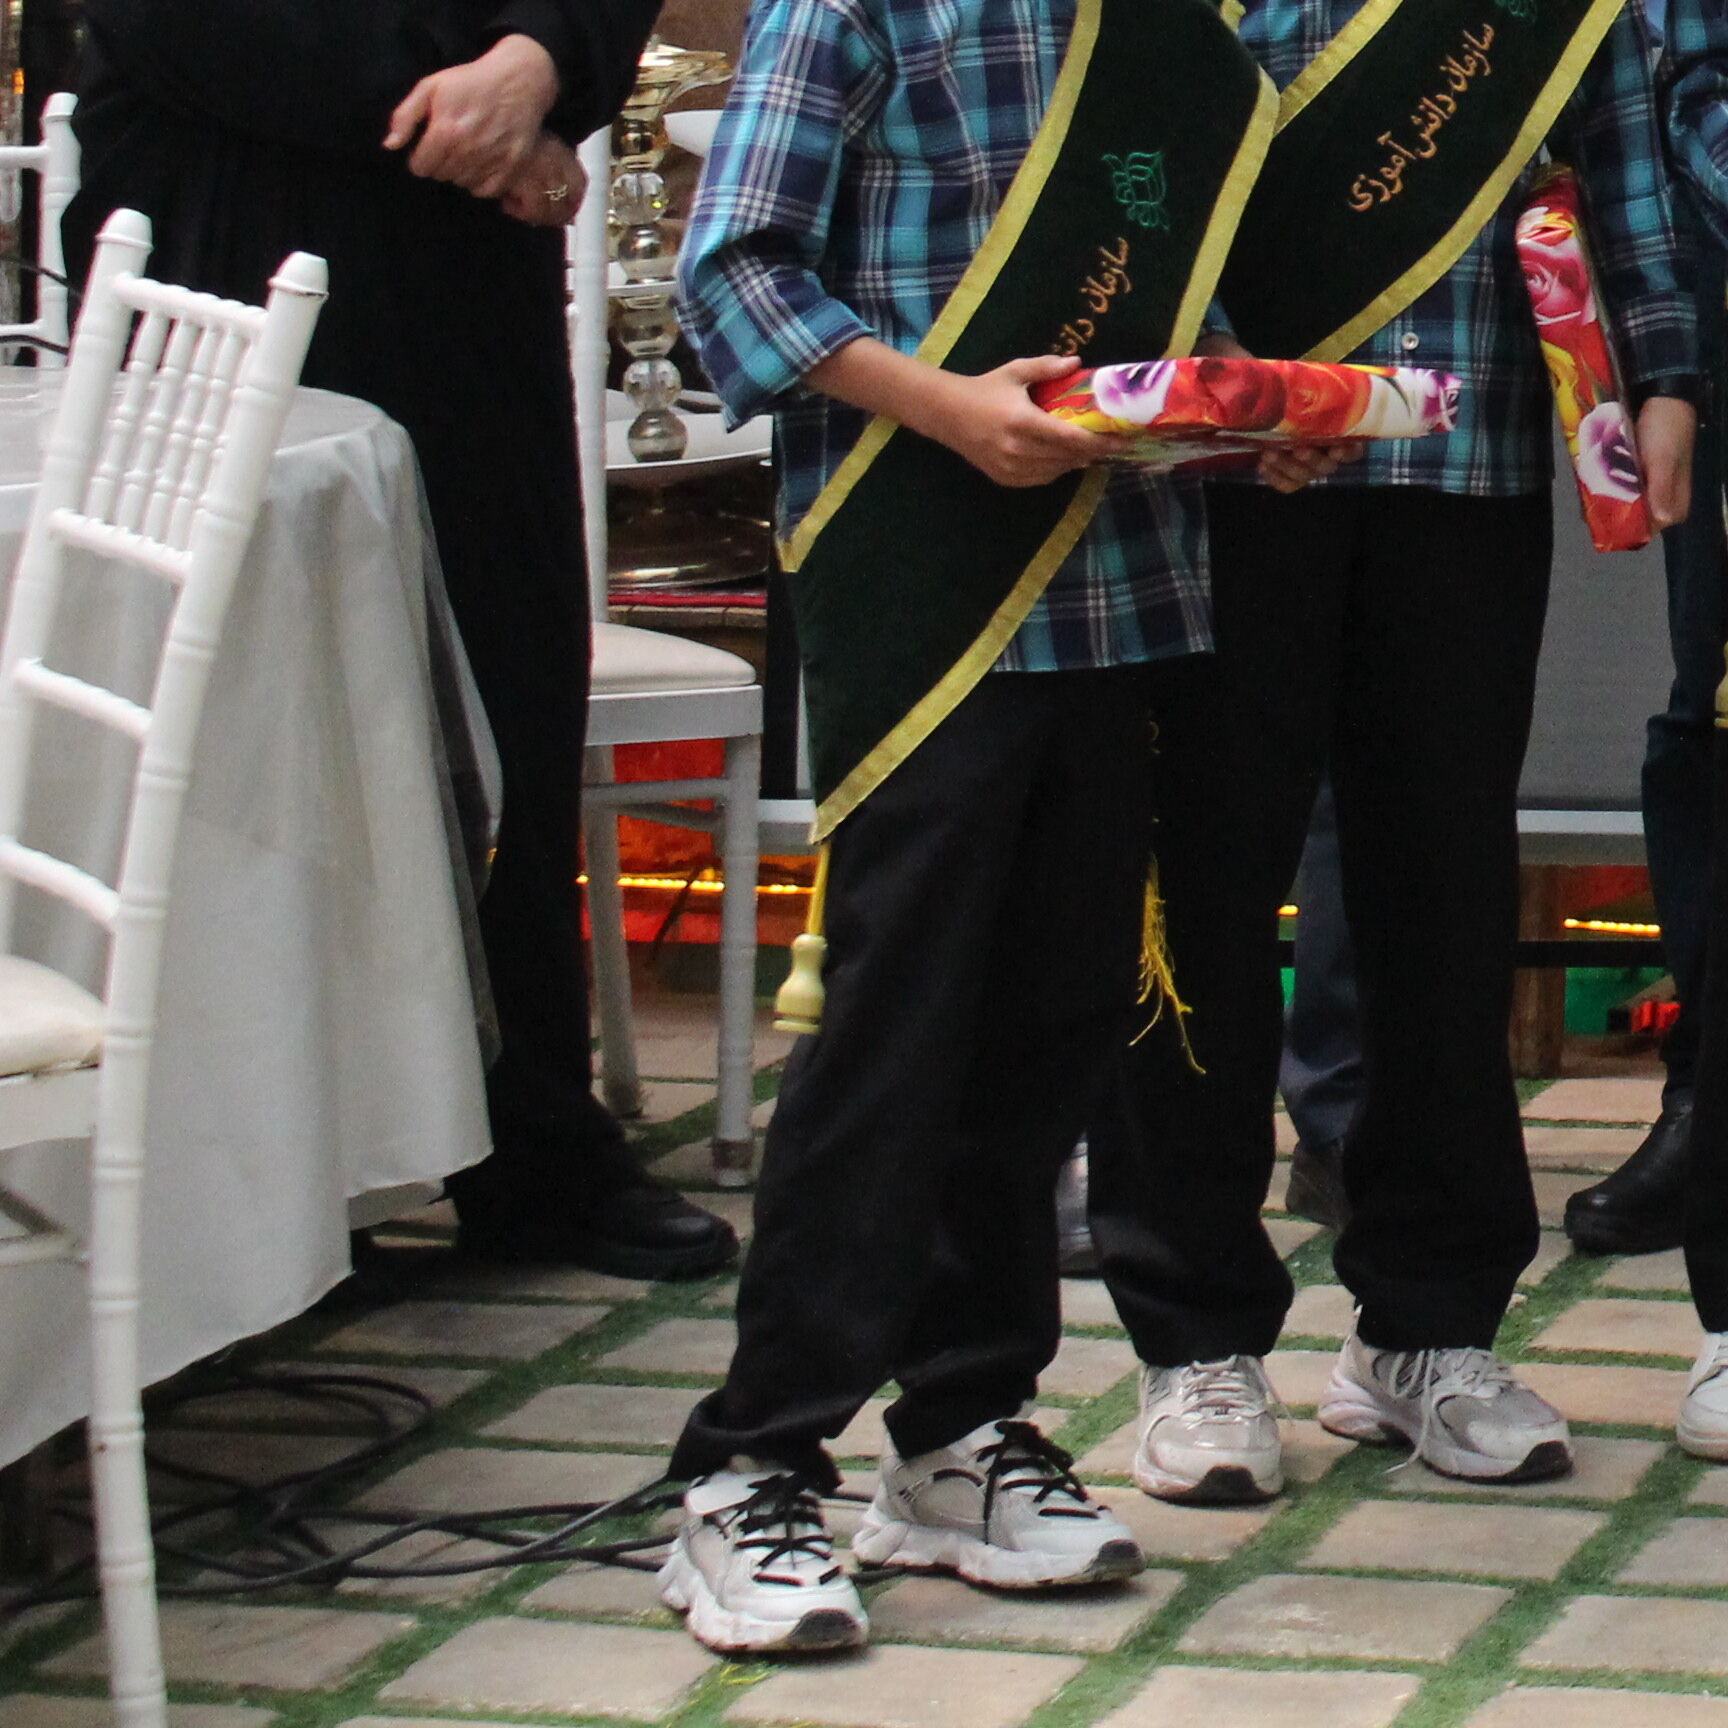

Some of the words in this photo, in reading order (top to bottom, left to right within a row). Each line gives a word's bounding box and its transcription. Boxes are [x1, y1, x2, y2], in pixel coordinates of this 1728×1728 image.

[1437, 22, 1497, 93] سازمان
[1411, 93, 1459, 160] دانش
[1348, 129, 1416, 212] آموزی
[1080, 237, 1132, 314] سازمان
